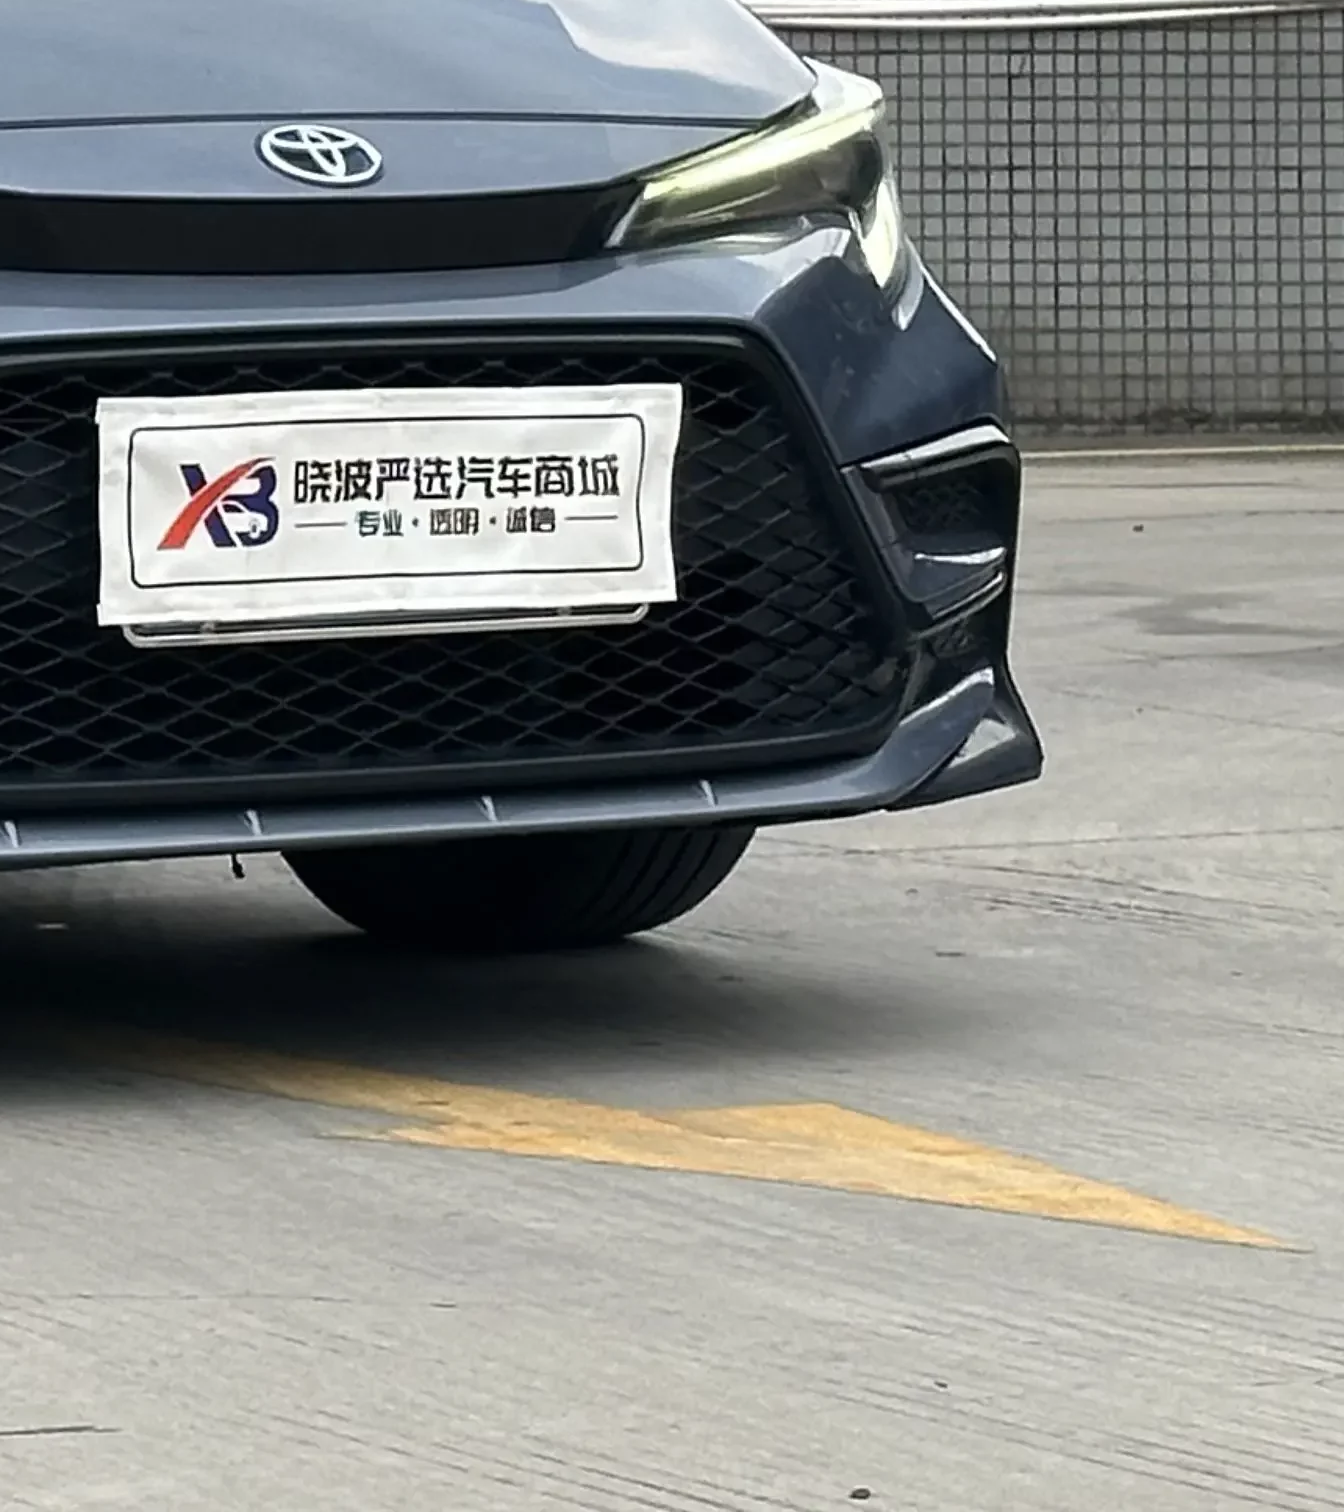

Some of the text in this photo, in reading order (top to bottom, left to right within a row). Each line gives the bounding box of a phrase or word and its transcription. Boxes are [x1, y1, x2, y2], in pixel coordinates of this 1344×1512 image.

[293, 453, 621, 503] 晓波严选汽车商城
